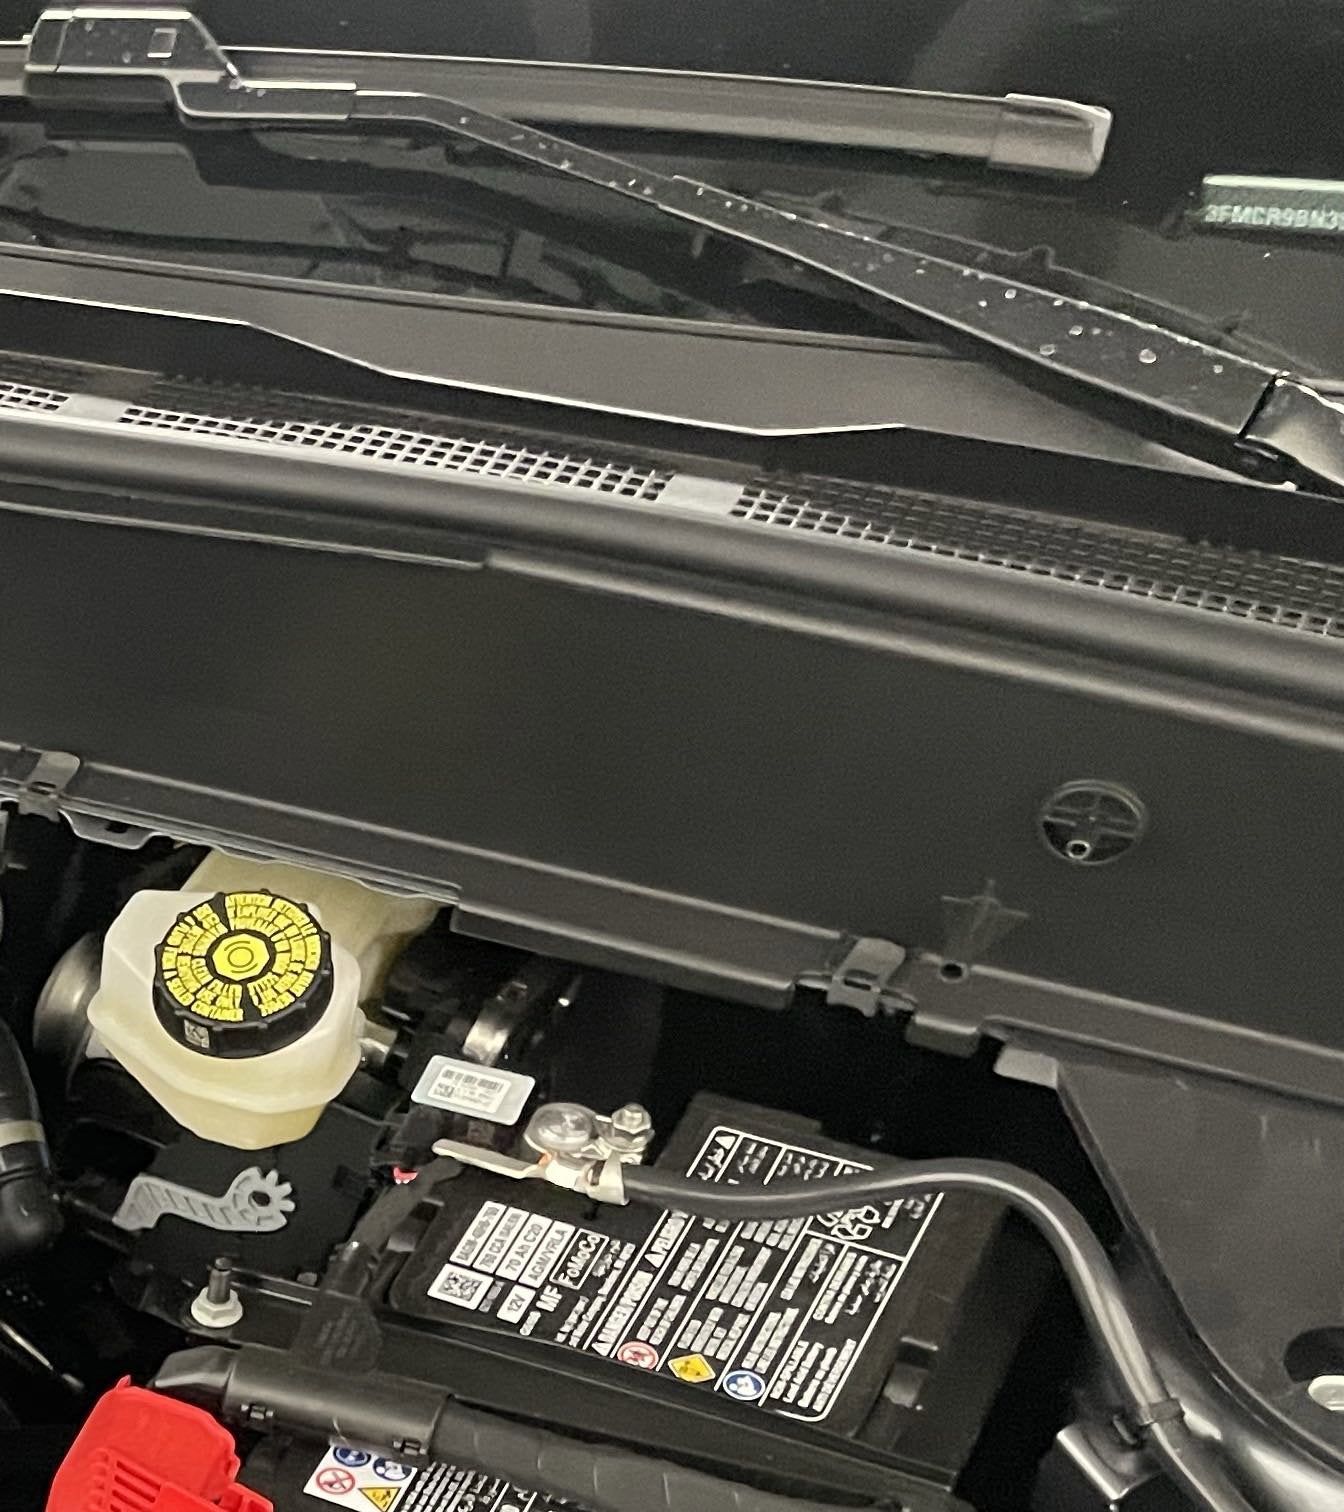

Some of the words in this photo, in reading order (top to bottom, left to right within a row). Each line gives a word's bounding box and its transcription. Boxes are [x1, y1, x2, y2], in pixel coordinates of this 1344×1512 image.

[504, 1258, 522, 1272] 70
[515, 1245, 531, 1258] Ah
[523, 1224, 543, 1242] C20
[528, 1230, 567, 1281] AGM/VRLA
[558, 1232, 602, 1286] FoMoCo
[507, 1294, 525, 1312] 12V
[536, 1285, 562, 1311] MF
